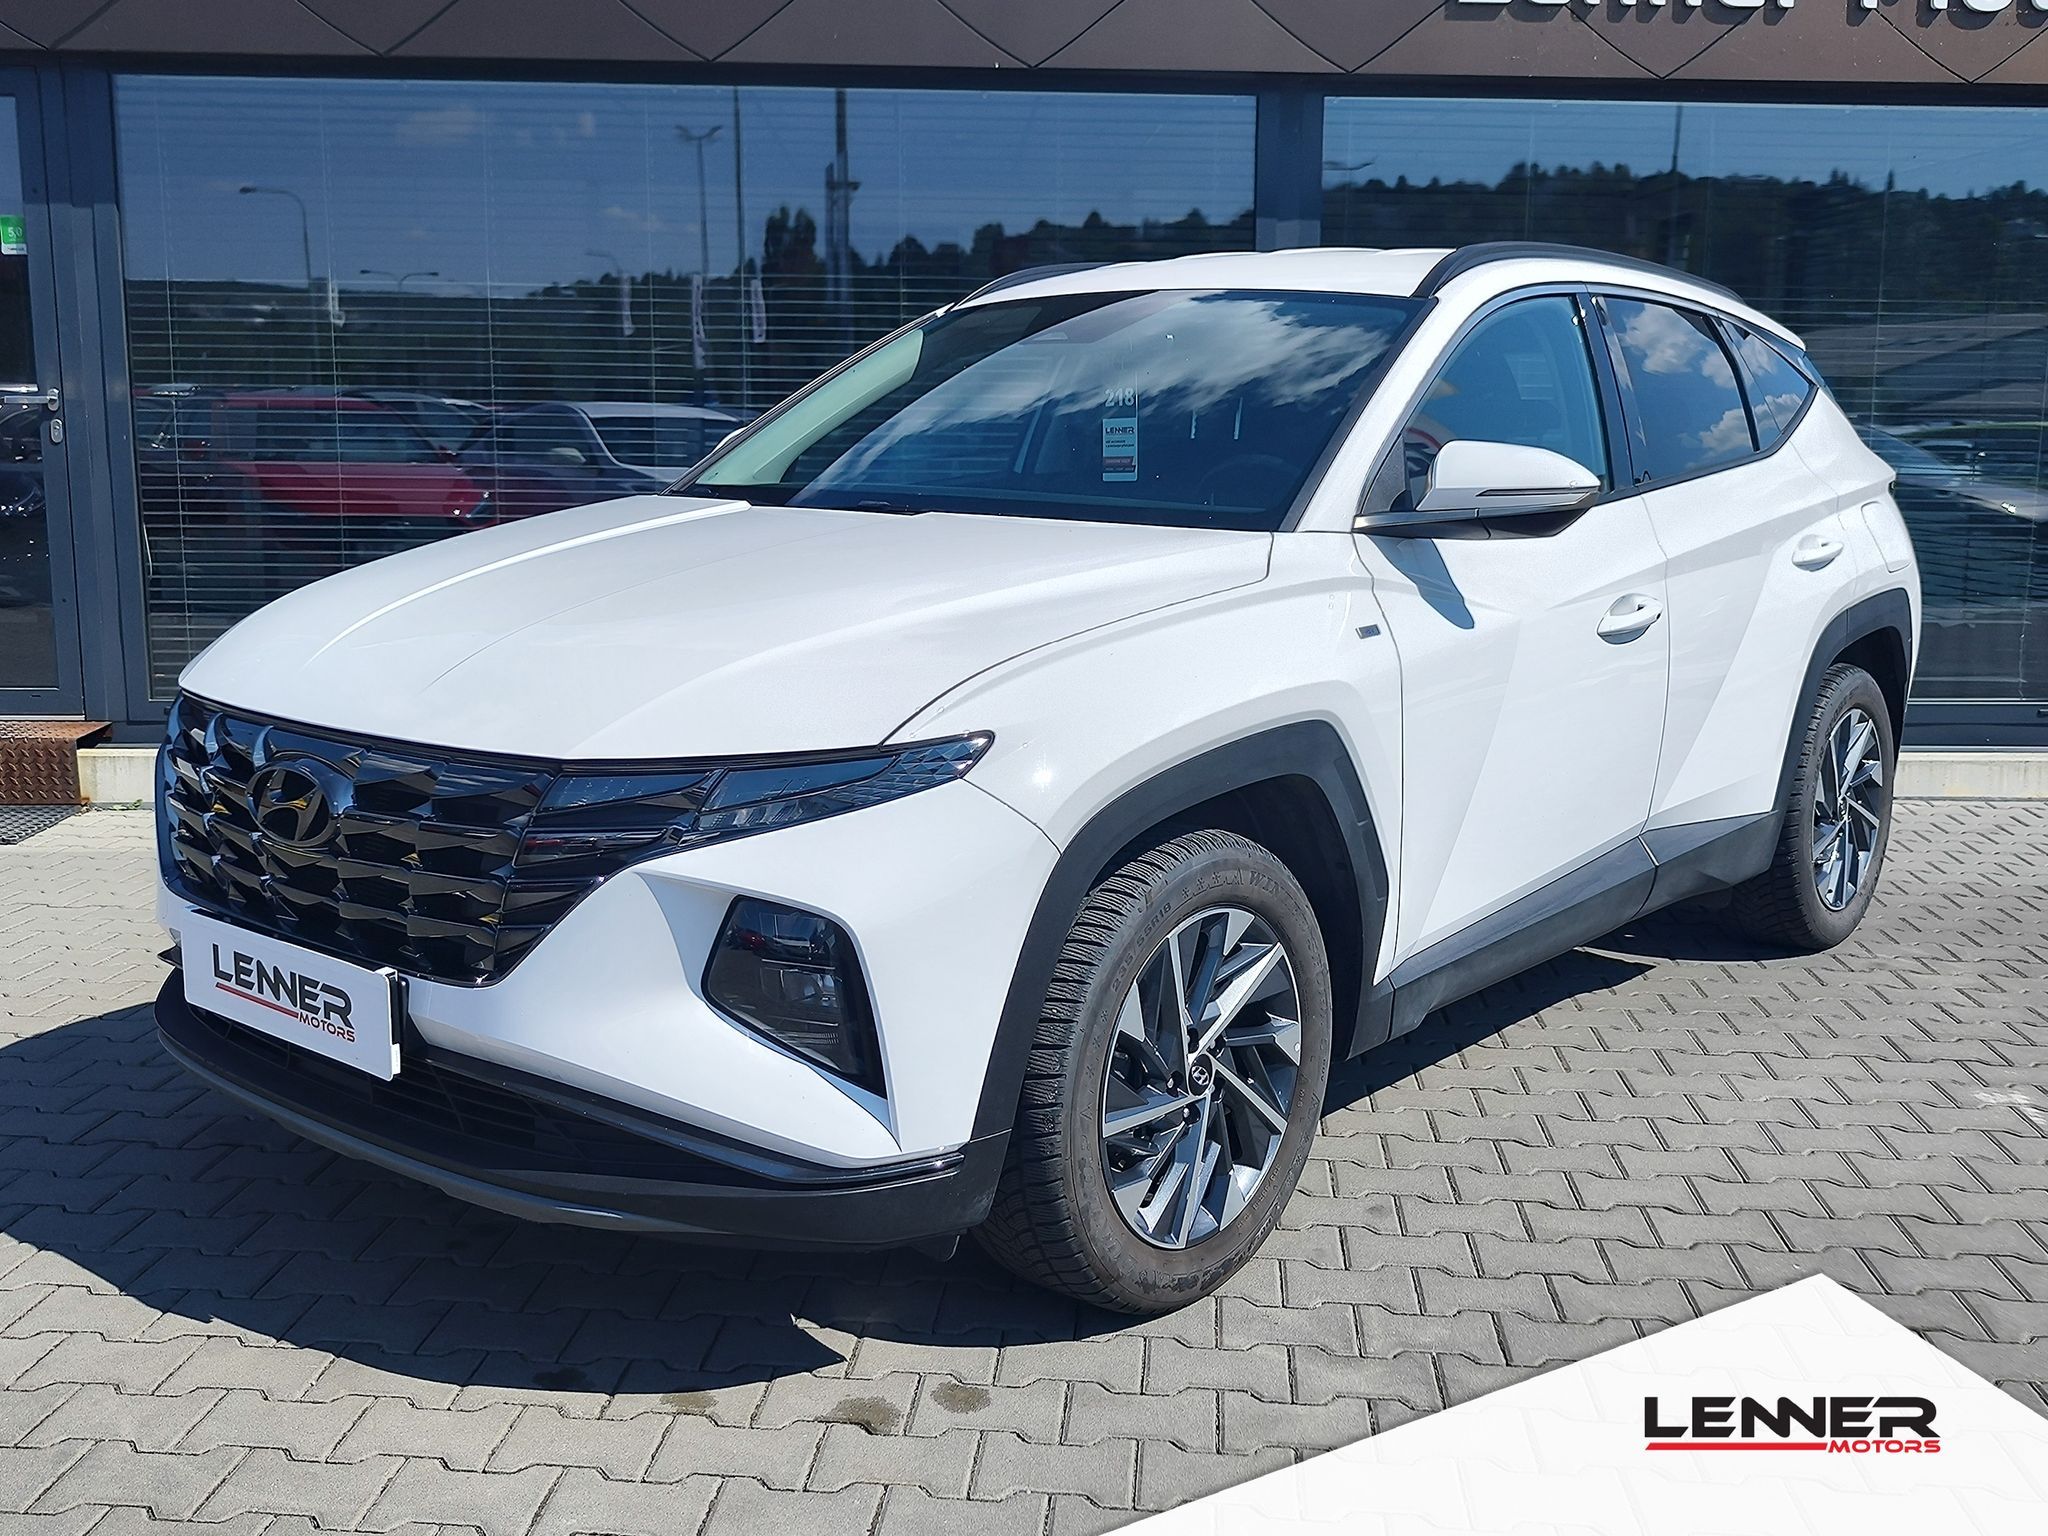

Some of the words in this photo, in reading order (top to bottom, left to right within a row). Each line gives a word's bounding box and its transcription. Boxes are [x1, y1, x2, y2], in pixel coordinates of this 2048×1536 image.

[1105, 388, 1135, 407] 218
[212, 943, 355, 1030] LENNER
[299, 1011, 356, 1043] MOTORS
